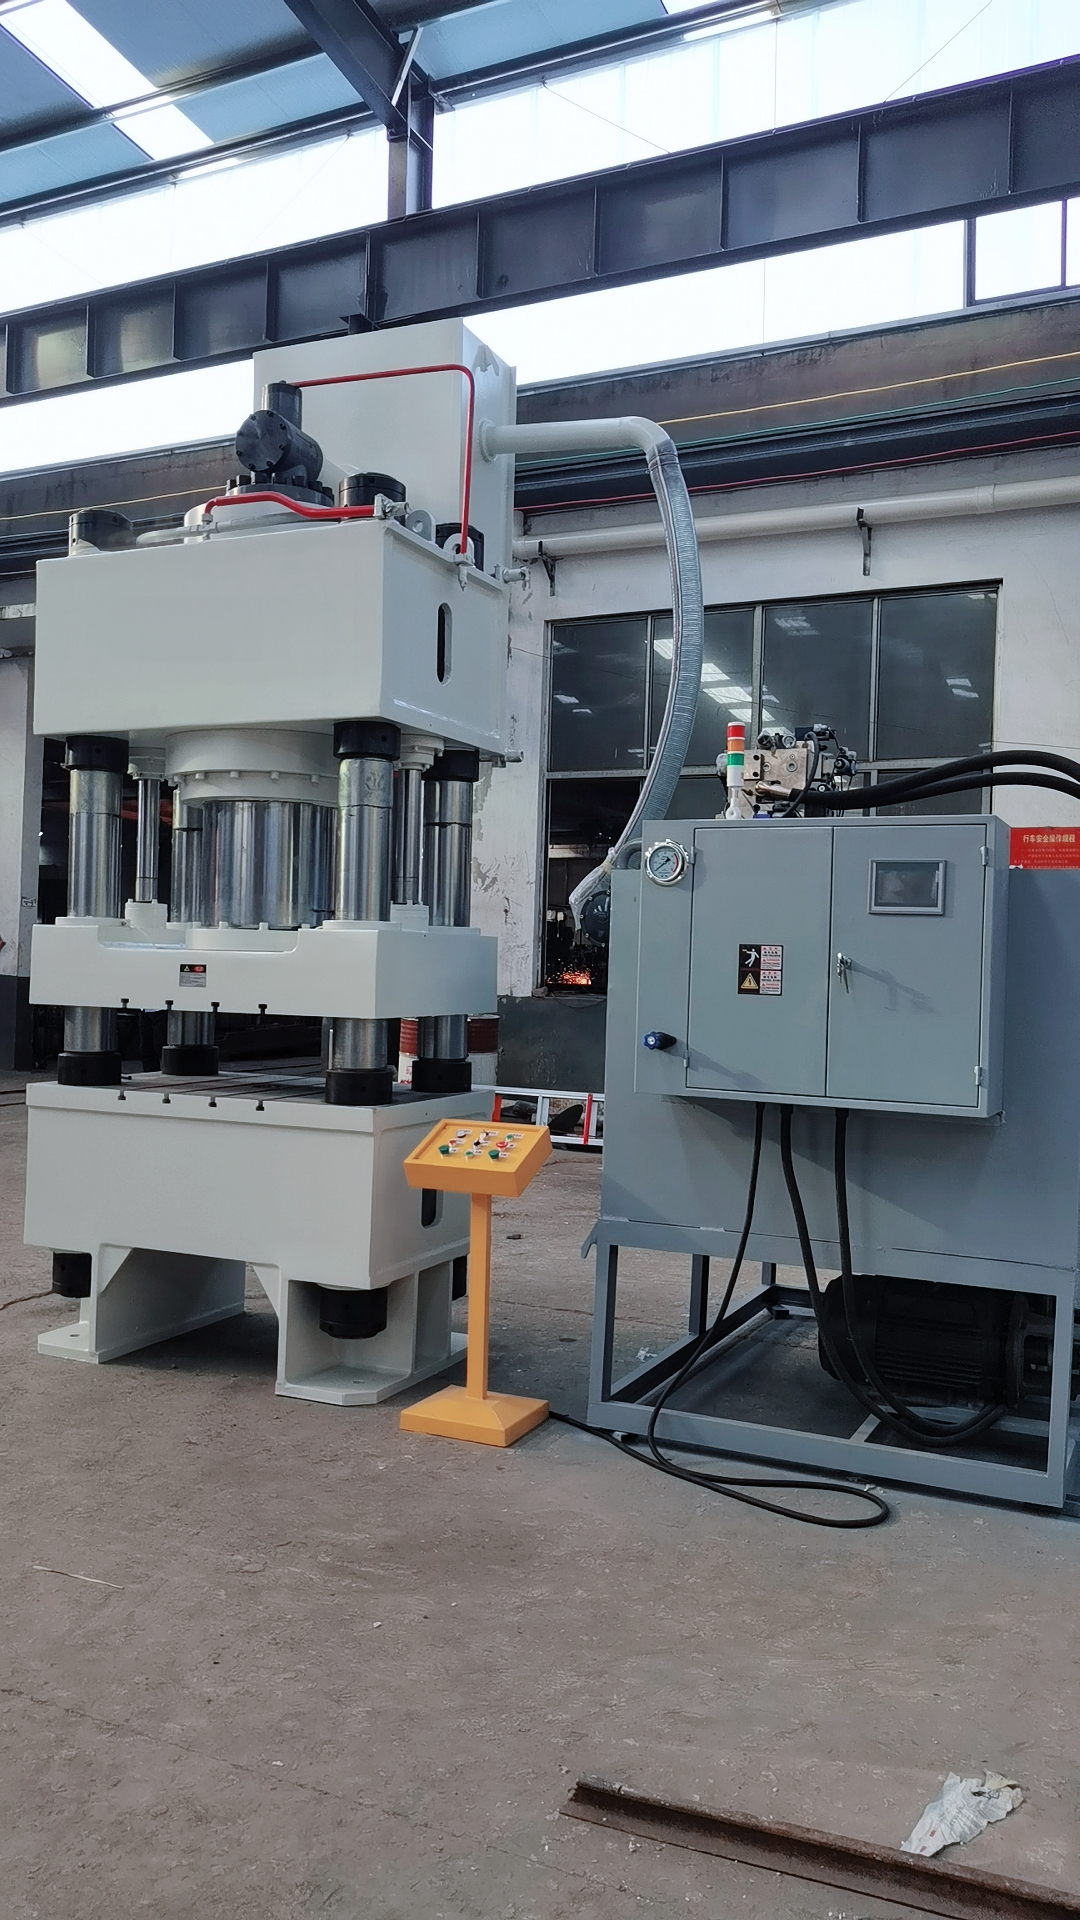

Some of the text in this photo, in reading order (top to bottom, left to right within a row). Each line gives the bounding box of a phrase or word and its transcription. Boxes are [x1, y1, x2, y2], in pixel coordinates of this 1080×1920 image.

[1022, 834, 1076, 843] 行车安全操作规程
